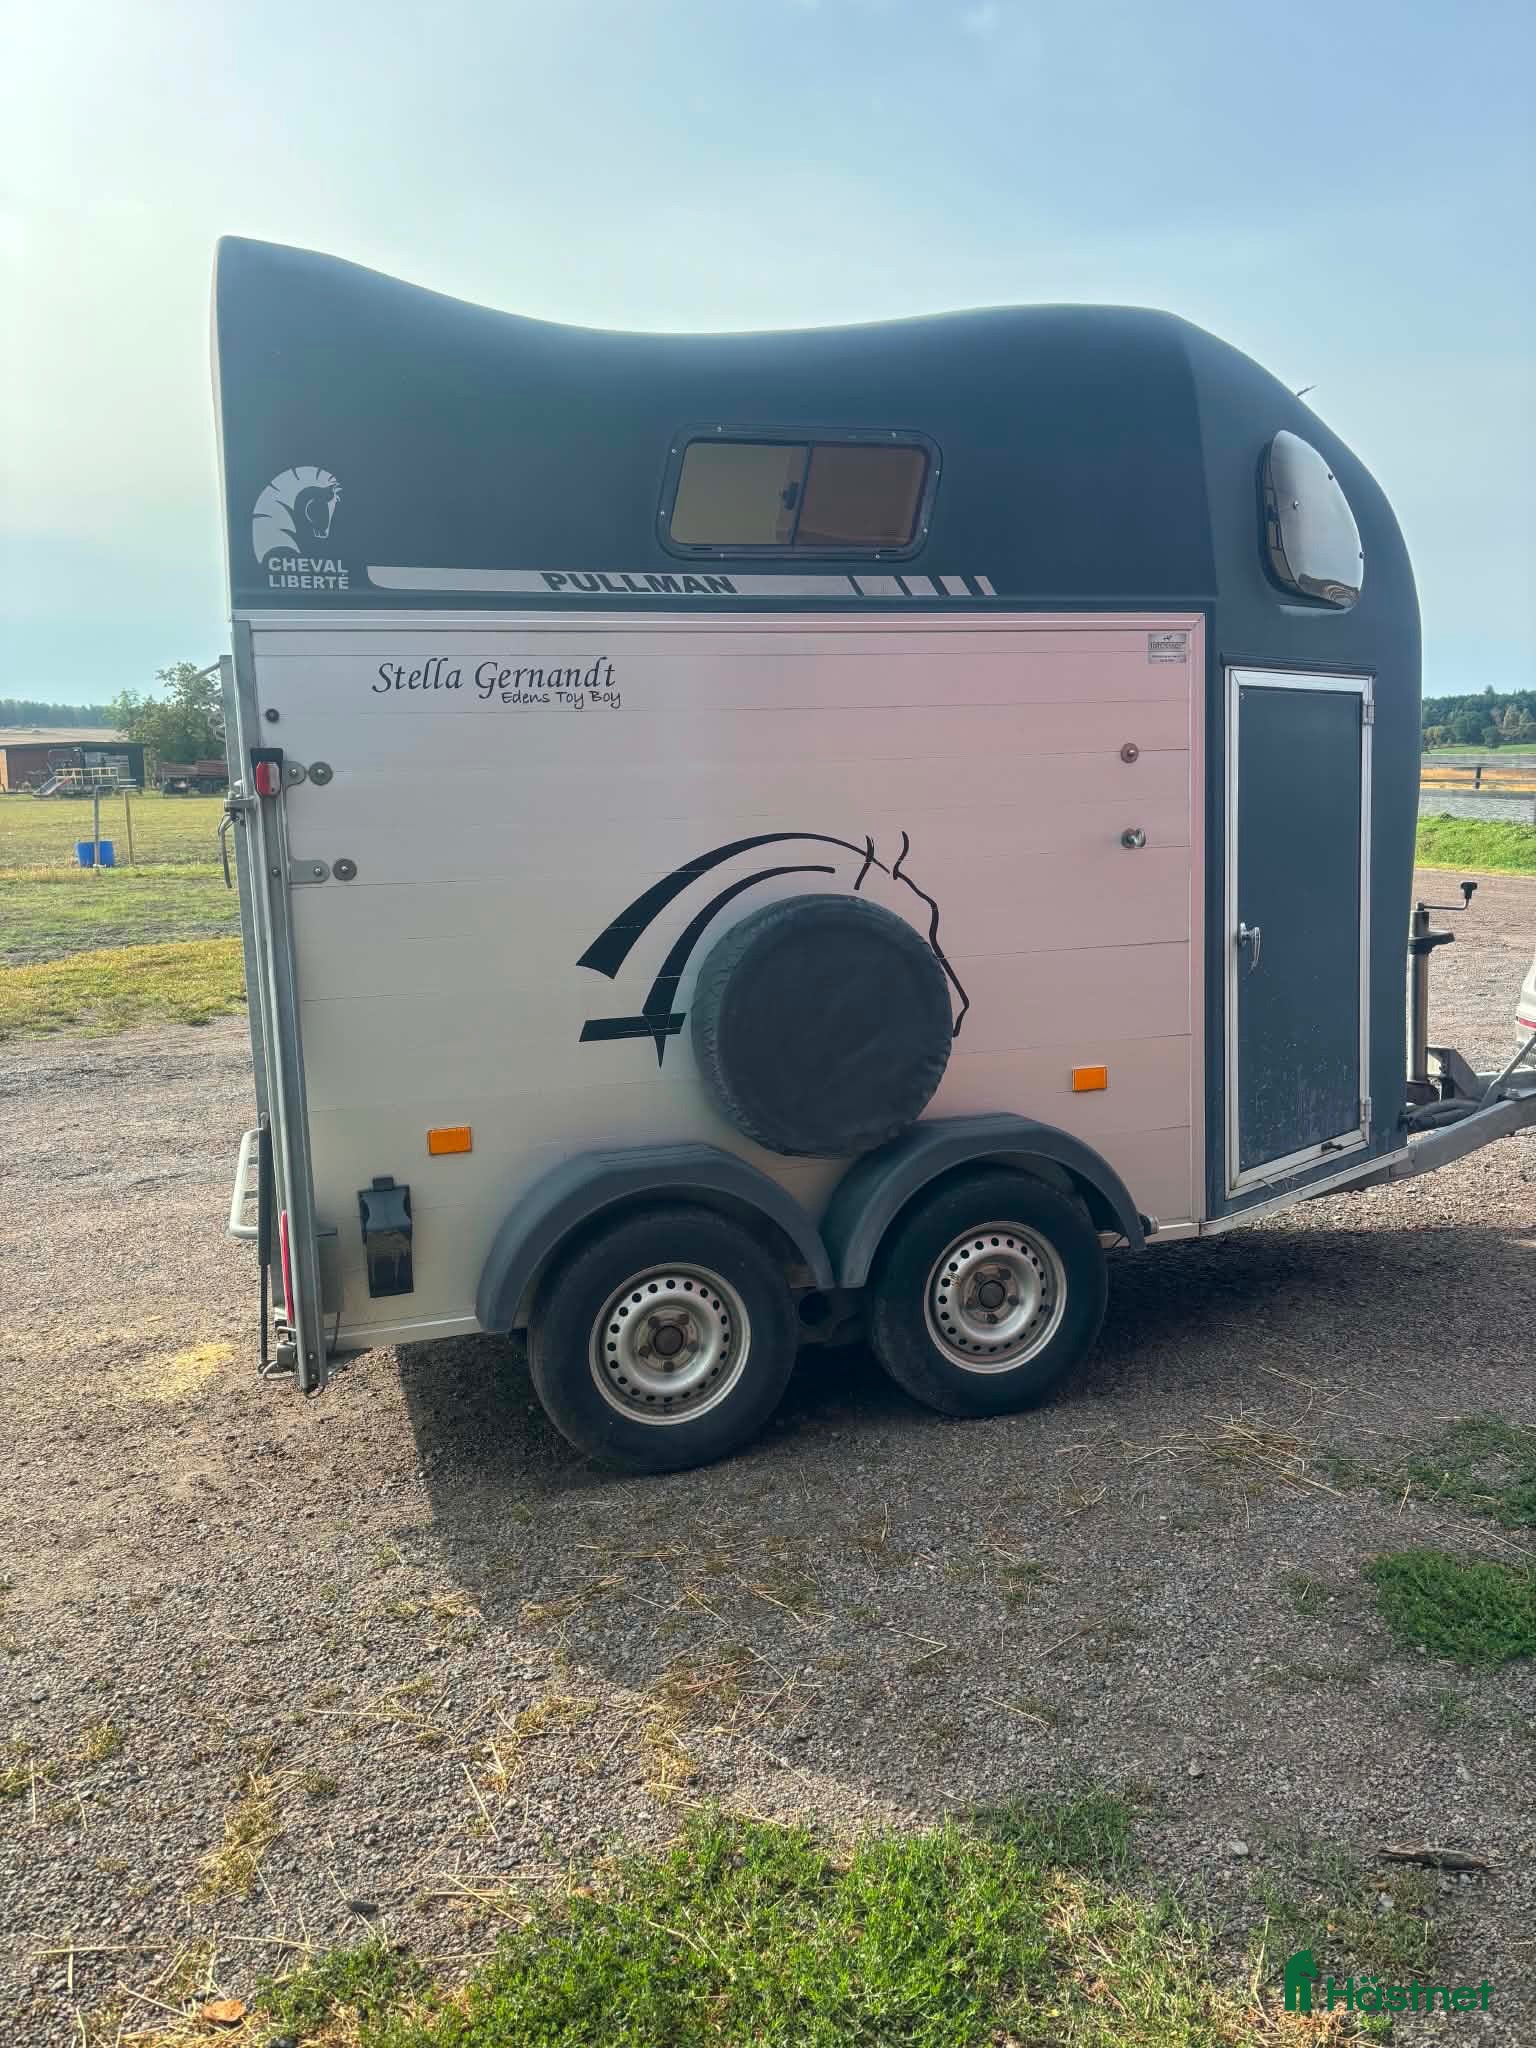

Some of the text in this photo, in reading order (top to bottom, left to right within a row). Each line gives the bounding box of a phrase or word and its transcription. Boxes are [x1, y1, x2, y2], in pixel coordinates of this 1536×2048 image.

[268, 557, 349, 573] CHEVAL
[540, 572, 738, 594] PULLMAN
[371, 656, 616, 699] Stella Gernandt
[501, 690, 621, 710] Edens Toy Boy
